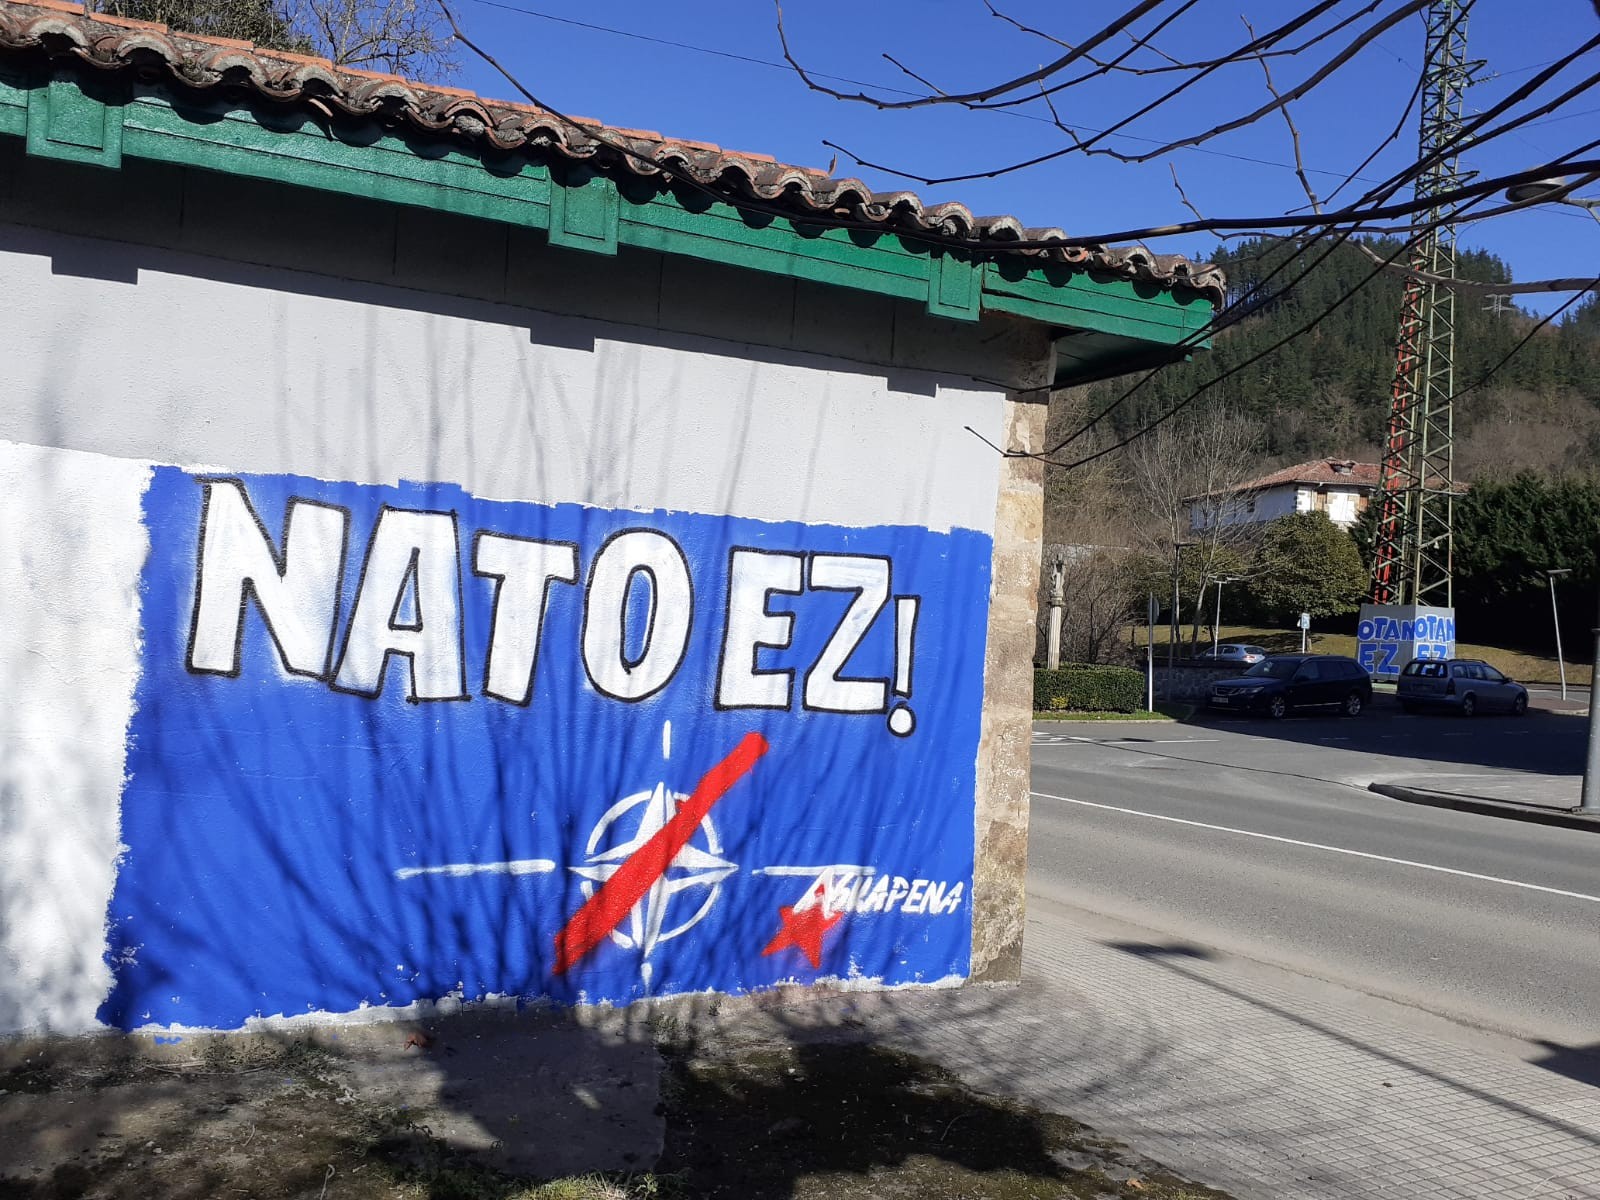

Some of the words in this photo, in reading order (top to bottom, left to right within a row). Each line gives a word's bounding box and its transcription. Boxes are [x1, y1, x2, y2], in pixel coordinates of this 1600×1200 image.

[185, 477, 695, 707] NATO
[713, 546, 923, 738] EZ!
[1358, 616, 1415, 641] OTAN
[1415, 614, 1455, 643] OTAN
[1358, 642, 1401, 675] EZ
